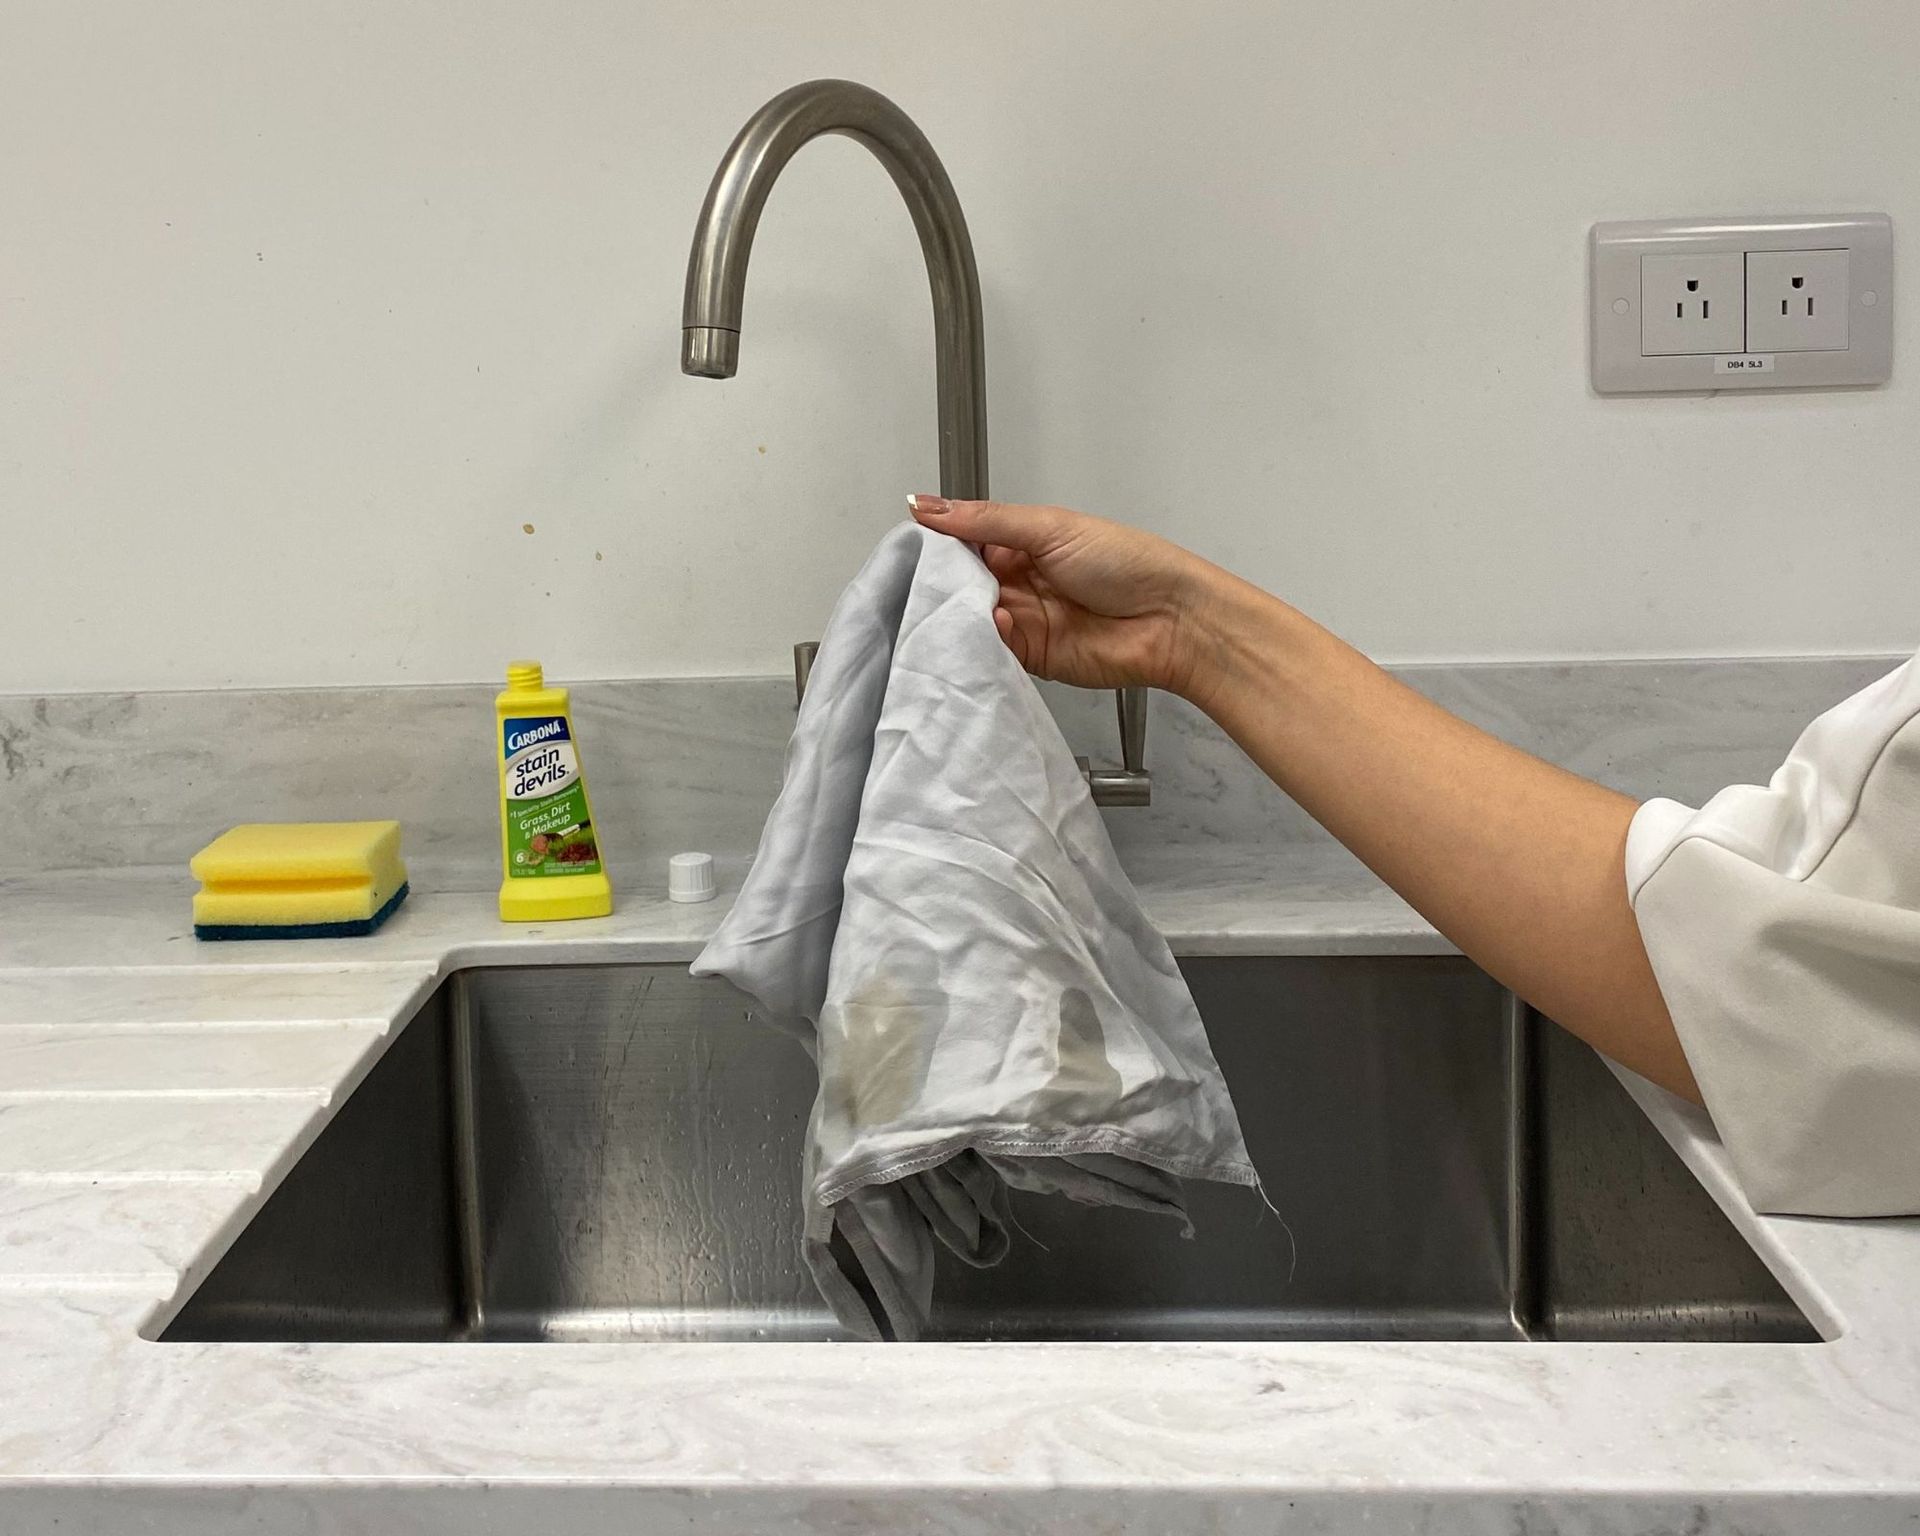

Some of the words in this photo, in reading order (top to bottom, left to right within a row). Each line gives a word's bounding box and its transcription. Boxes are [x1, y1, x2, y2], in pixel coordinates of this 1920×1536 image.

[508, 720, 561, 750] CARBONA
[516, 748, 560, 777] stain
[514, 763, 566, 796] devils
[551, 801, 571, 817] Dirt
[532, 813, 571, 837] Makeup
[516, 852, 524, 864] 6
